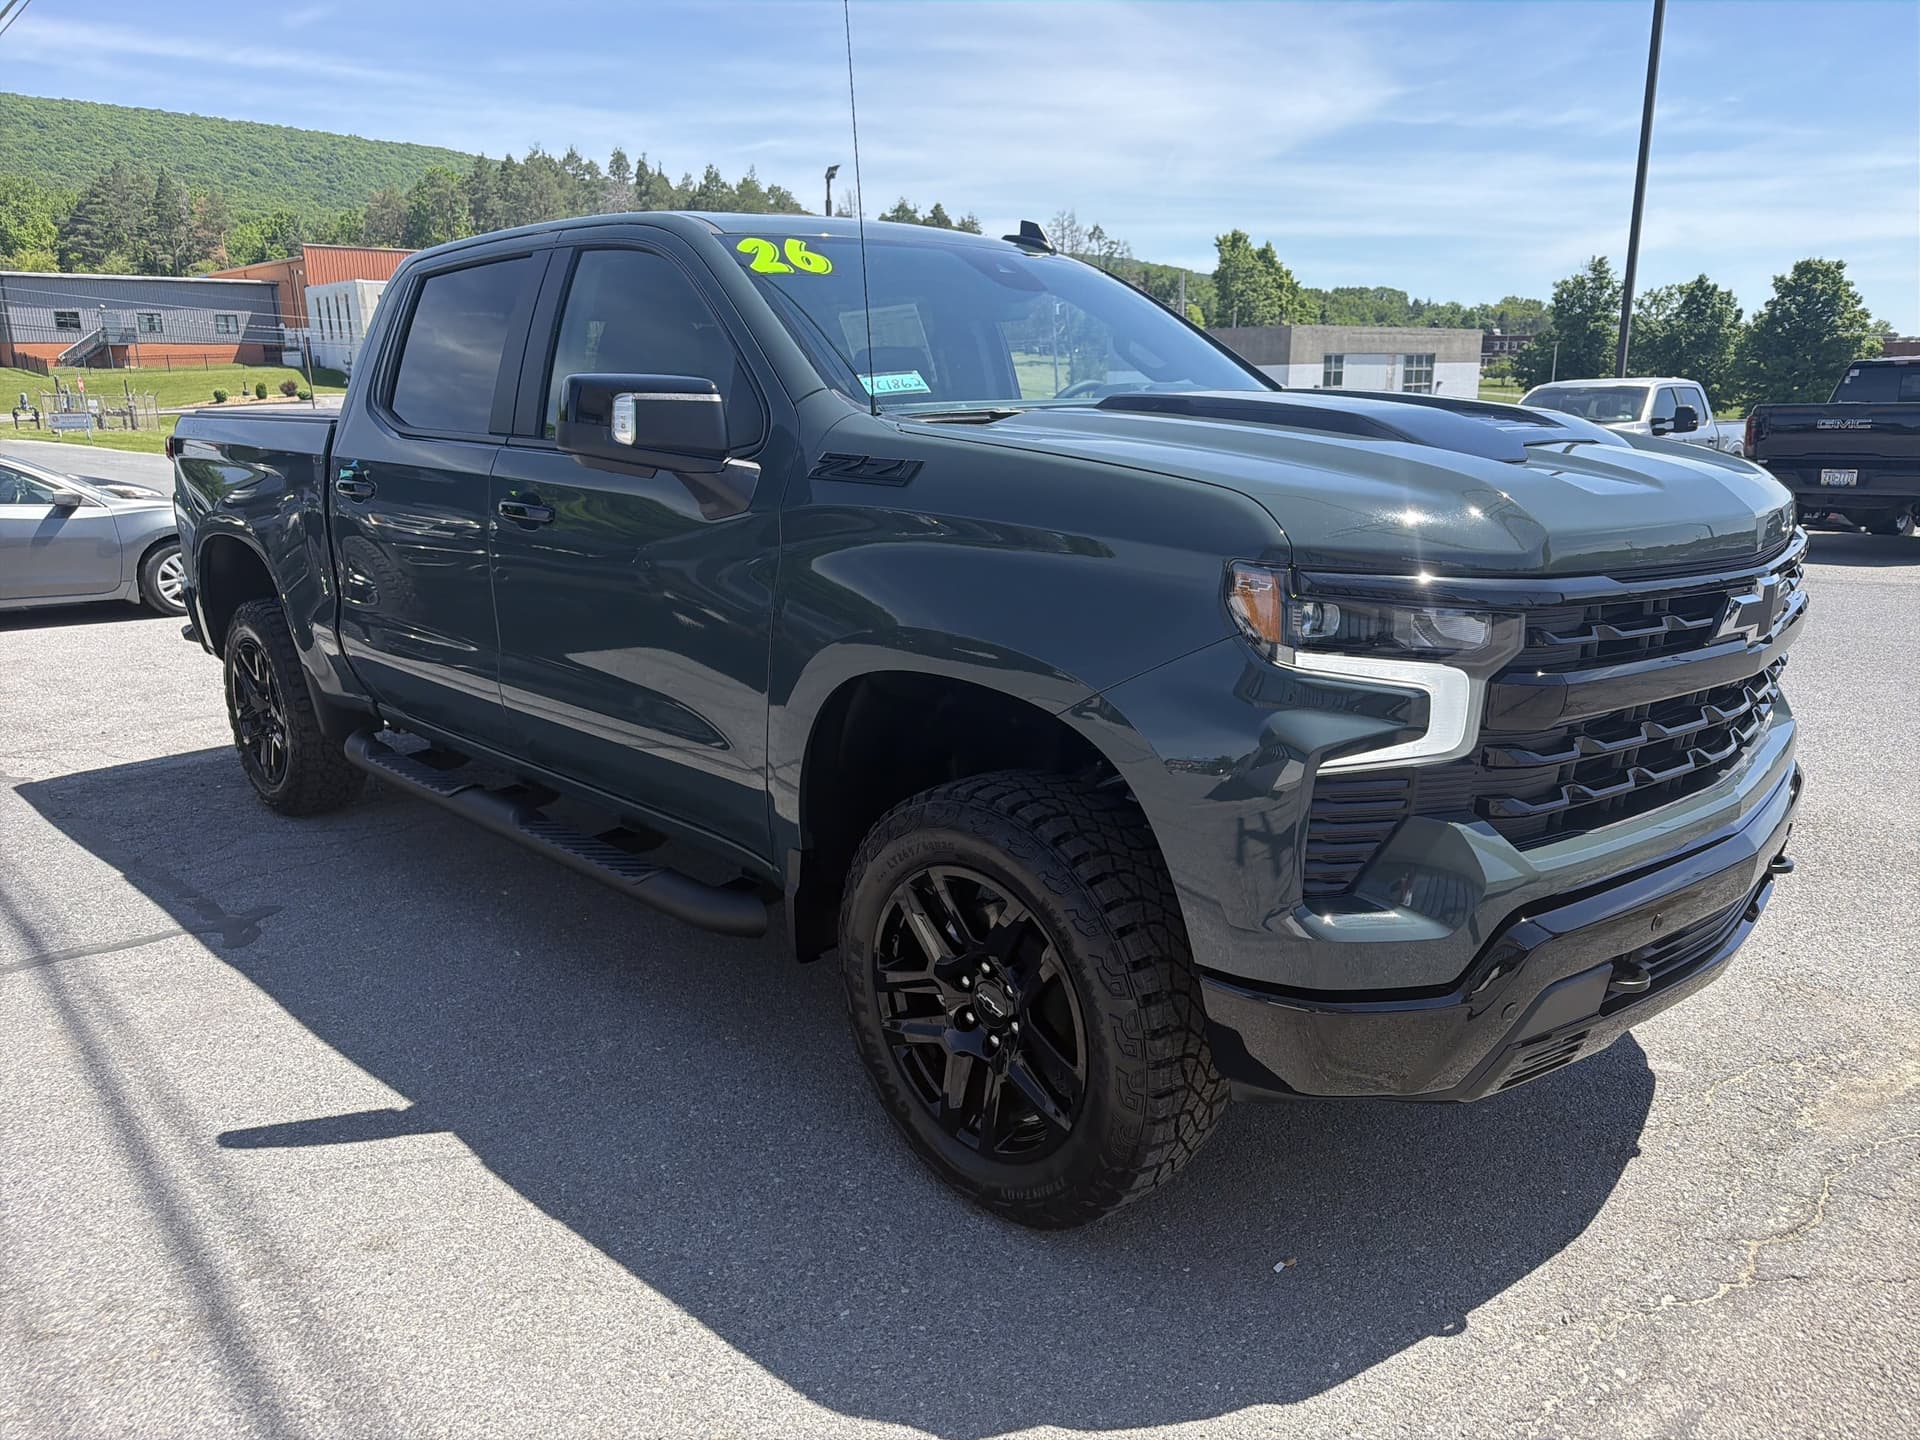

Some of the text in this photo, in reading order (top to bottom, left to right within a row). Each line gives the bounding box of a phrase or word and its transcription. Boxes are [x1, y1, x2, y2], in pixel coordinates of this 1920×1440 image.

[735, 237, 834, 275] 26
[1816, 418, 1873, 430] GMC
[807, 451, 925, 488] Z71
